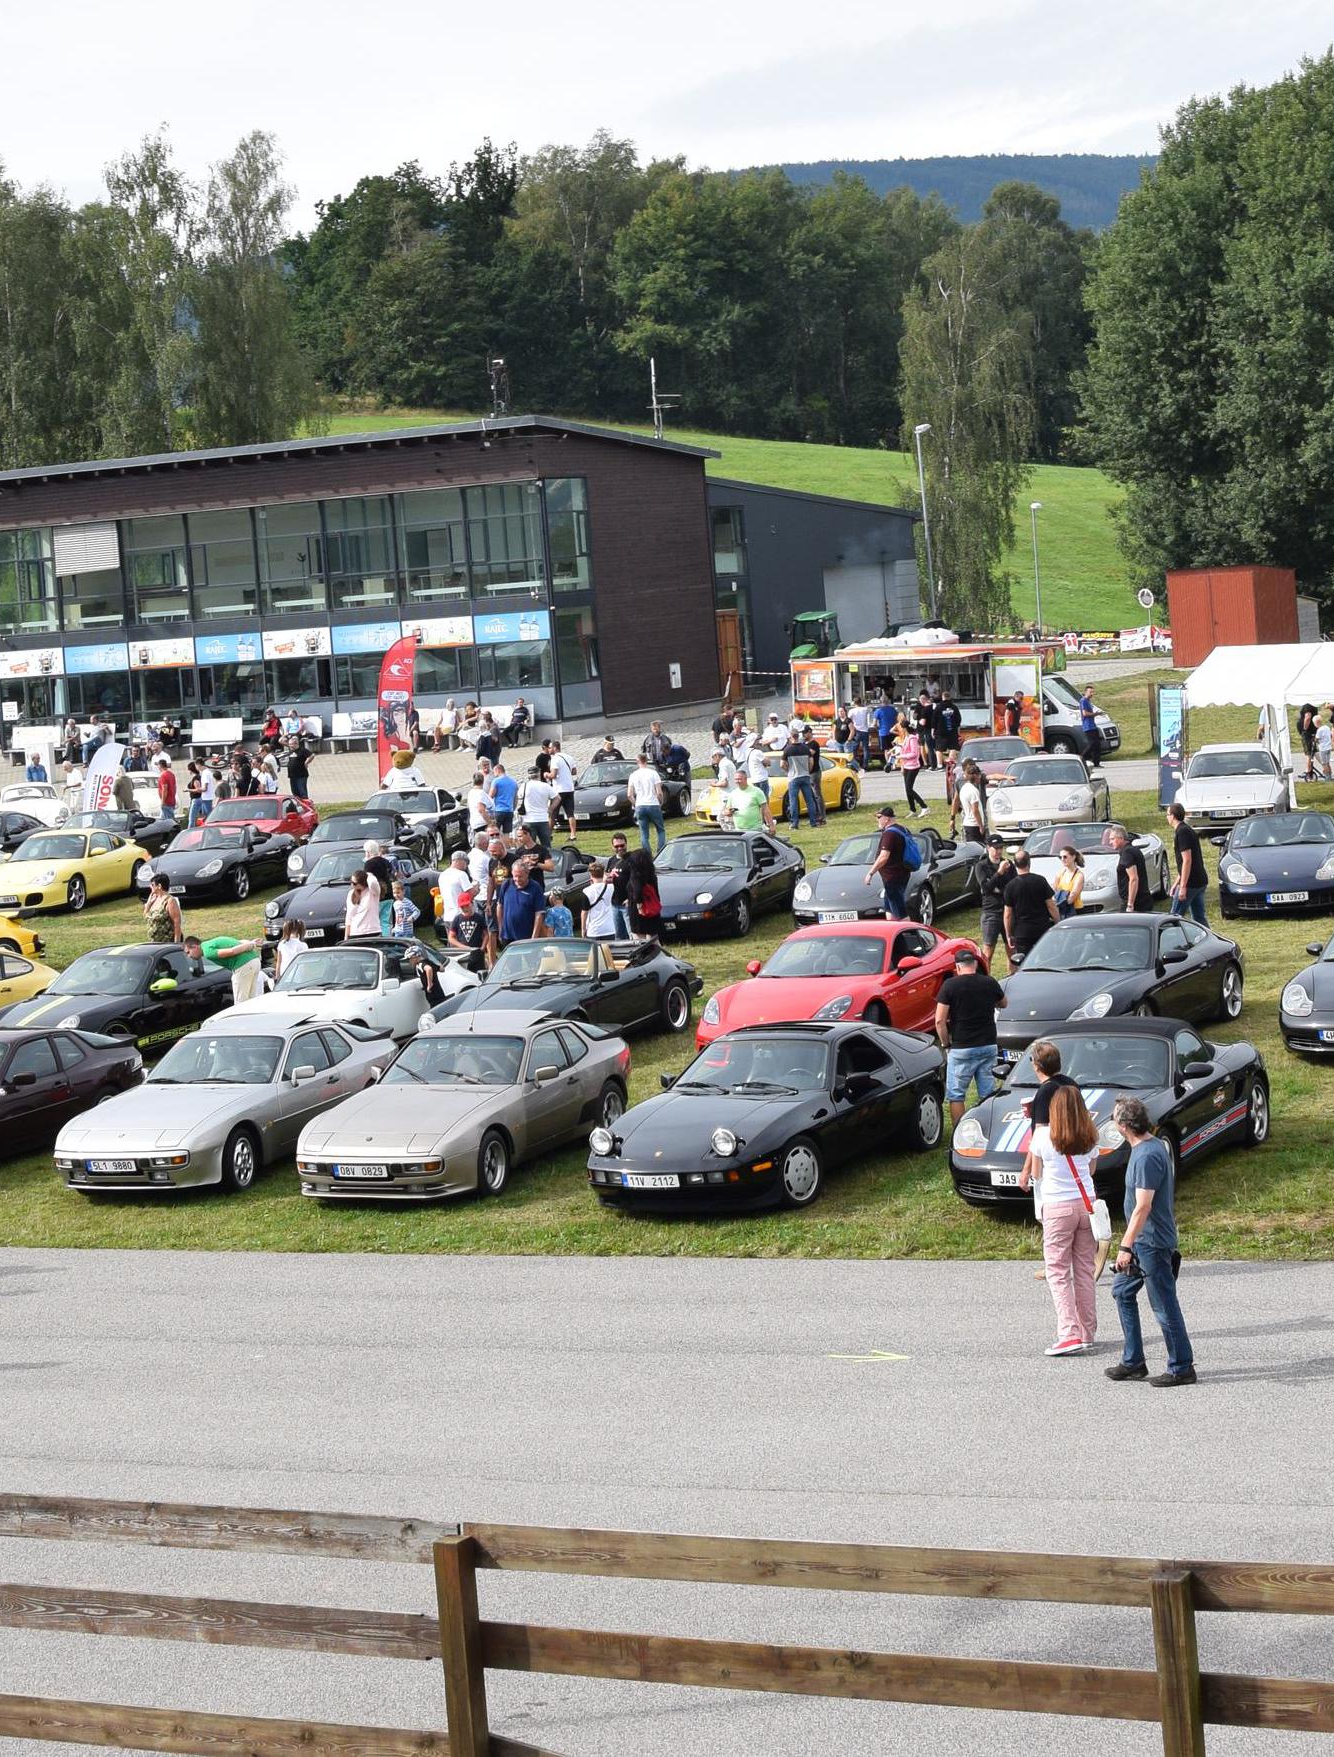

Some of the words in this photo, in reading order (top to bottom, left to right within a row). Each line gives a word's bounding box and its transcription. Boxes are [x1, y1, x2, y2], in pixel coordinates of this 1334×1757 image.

[149, 1023, 201, 1042] PORSCHE
[91, 1161, 107, 1170] 5L1
[113, 1161, 132, 1170] 9880
[340, 1166, 355, 1175] 08V
[362, 1166, 383, 1176] 0829
[629, 1176, 644, 1186] 11V
[652, 1176, 675, 1186] 2112
[999, 1174, 1017, 1185] 3A9
